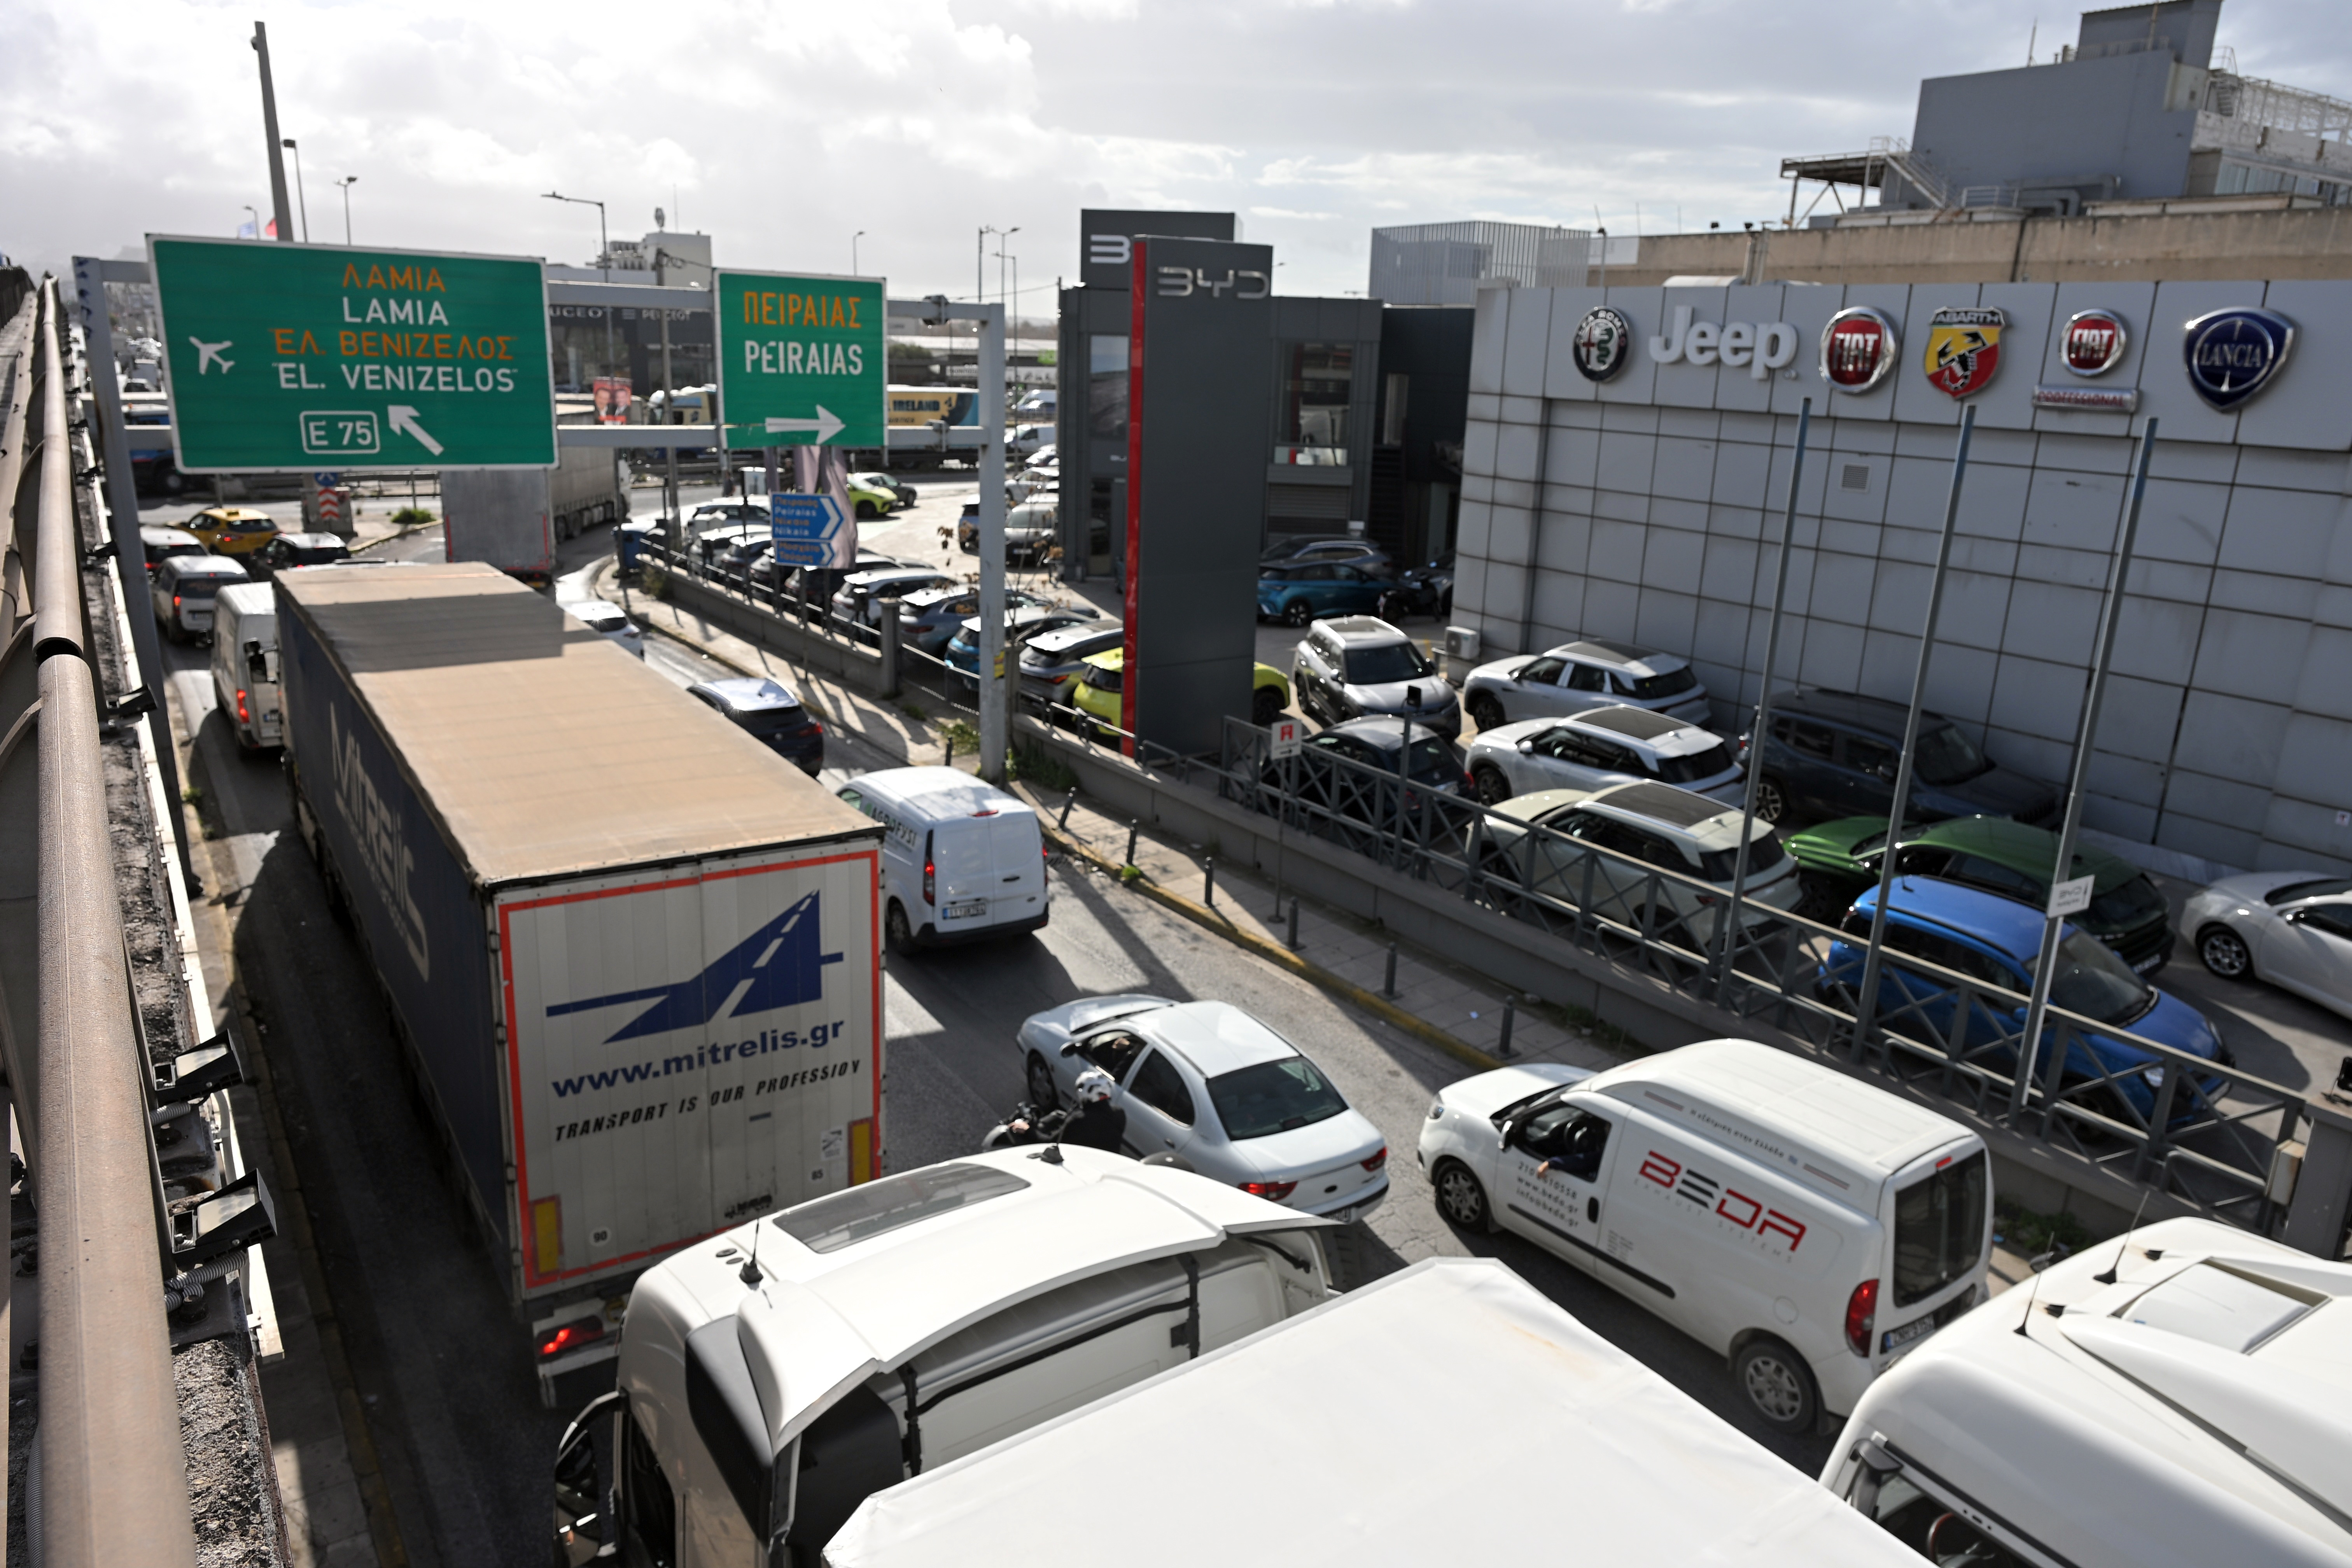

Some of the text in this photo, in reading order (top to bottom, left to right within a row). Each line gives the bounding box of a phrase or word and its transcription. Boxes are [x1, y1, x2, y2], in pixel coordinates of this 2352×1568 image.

[343, 263, 446, 292] ΛΑΜΙΑ
[1157, 266, 1270, 299] BYD
[343, 297, 449, 326] LAMIA
[744, 291, 861, 329] ΠΕΙΡΑΙΑΣ
[1935, 312, 1999, 324] ABARTH
[744, 340, 864, 375] PEIRAIAS
[1649, 306, 1799, 380] Jeep
[1832, 332, 1880, 372] FIAT
[2070, 328, 2114, 359] FIAT
[2200, 343, 2262, 368] LANCIA
[2037, 390, 2124, 408] PROFESSIONAL
[309, 421, 372, 446] E 75
[551, 1020, 844, 1098] www.mitrelis.gr
[555, 1103, 668, 1142] TRANSPORT
[678, 1096, 699, 1114] IS
[710, 1086, 744, 1106] OUR
